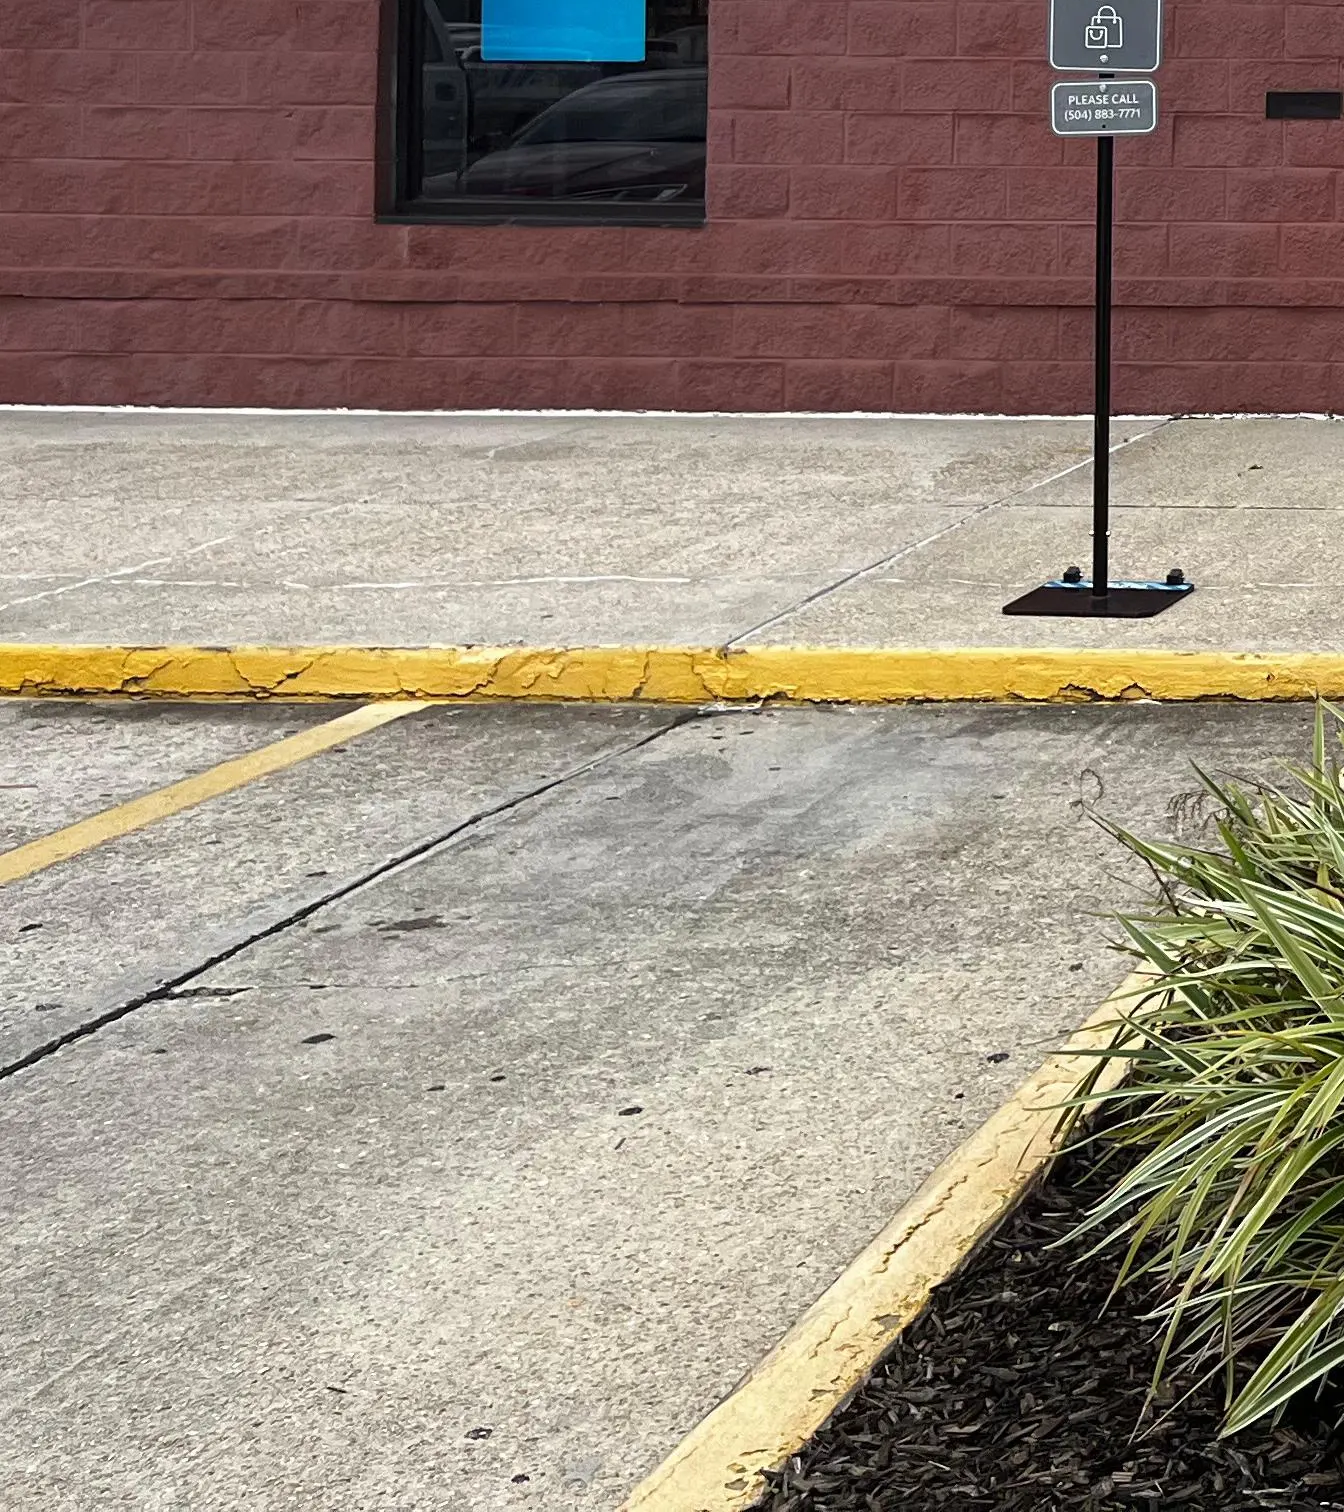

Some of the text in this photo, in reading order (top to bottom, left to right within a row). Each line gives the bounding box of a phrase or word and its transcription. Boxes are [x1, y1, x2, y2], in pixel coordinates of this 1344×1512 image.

[1068, 93, 1139, 105] PLEASE CALL
[1064, 108, 1141, 121] (504) 883-7771
